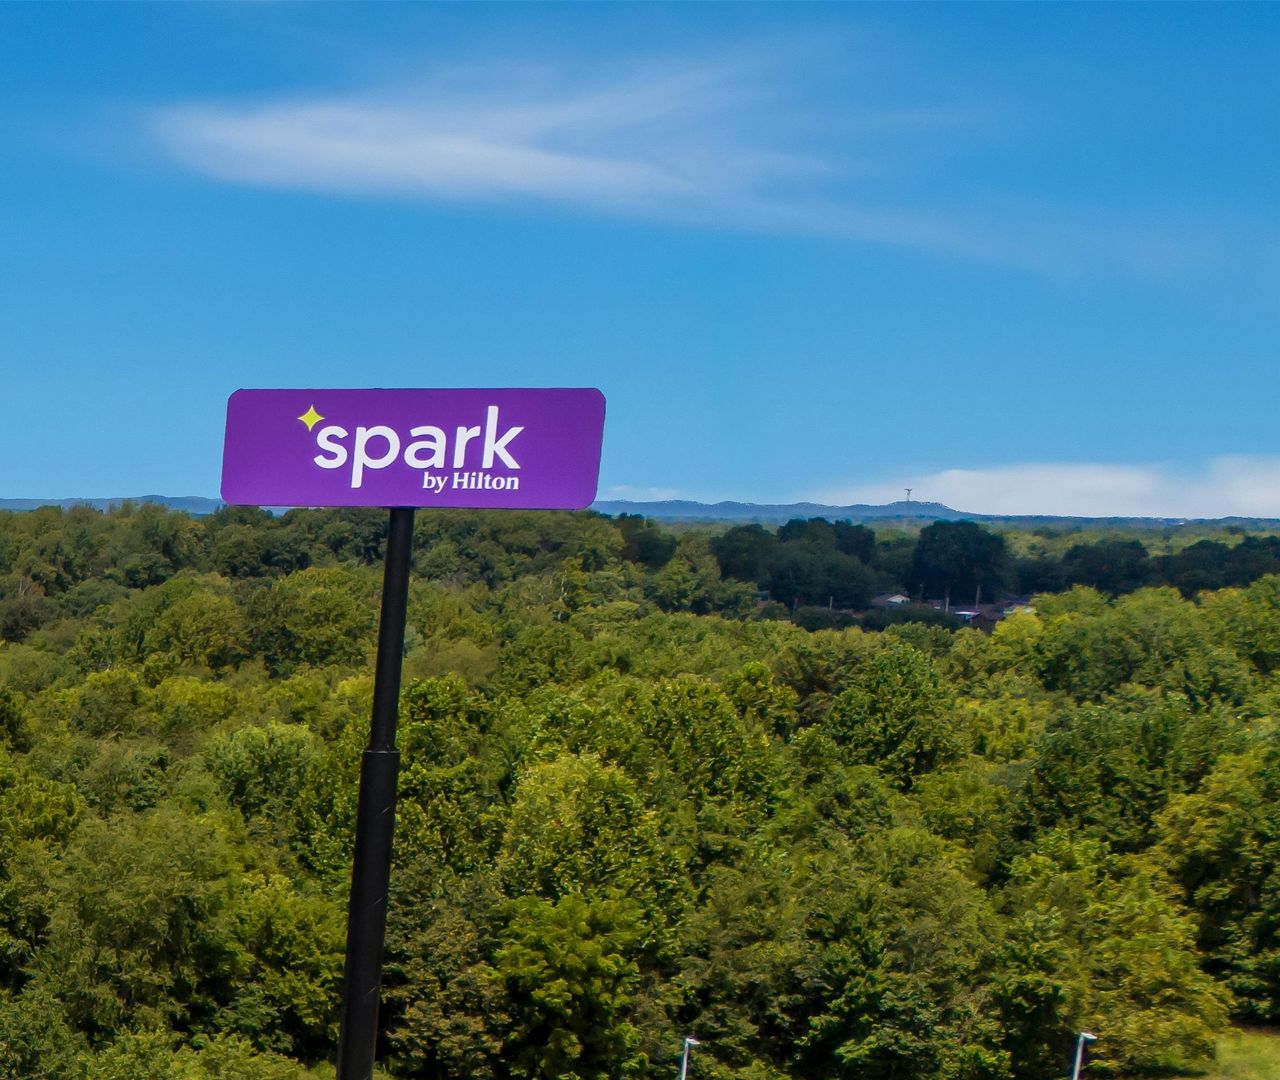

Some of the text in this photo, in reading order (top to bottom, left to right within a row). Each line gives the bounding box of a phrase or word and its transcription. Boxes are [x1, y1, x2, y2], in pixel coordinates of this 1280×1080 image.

[313, 405, 525, 489] spark
[422, 471, 519, 493] by Hilton
